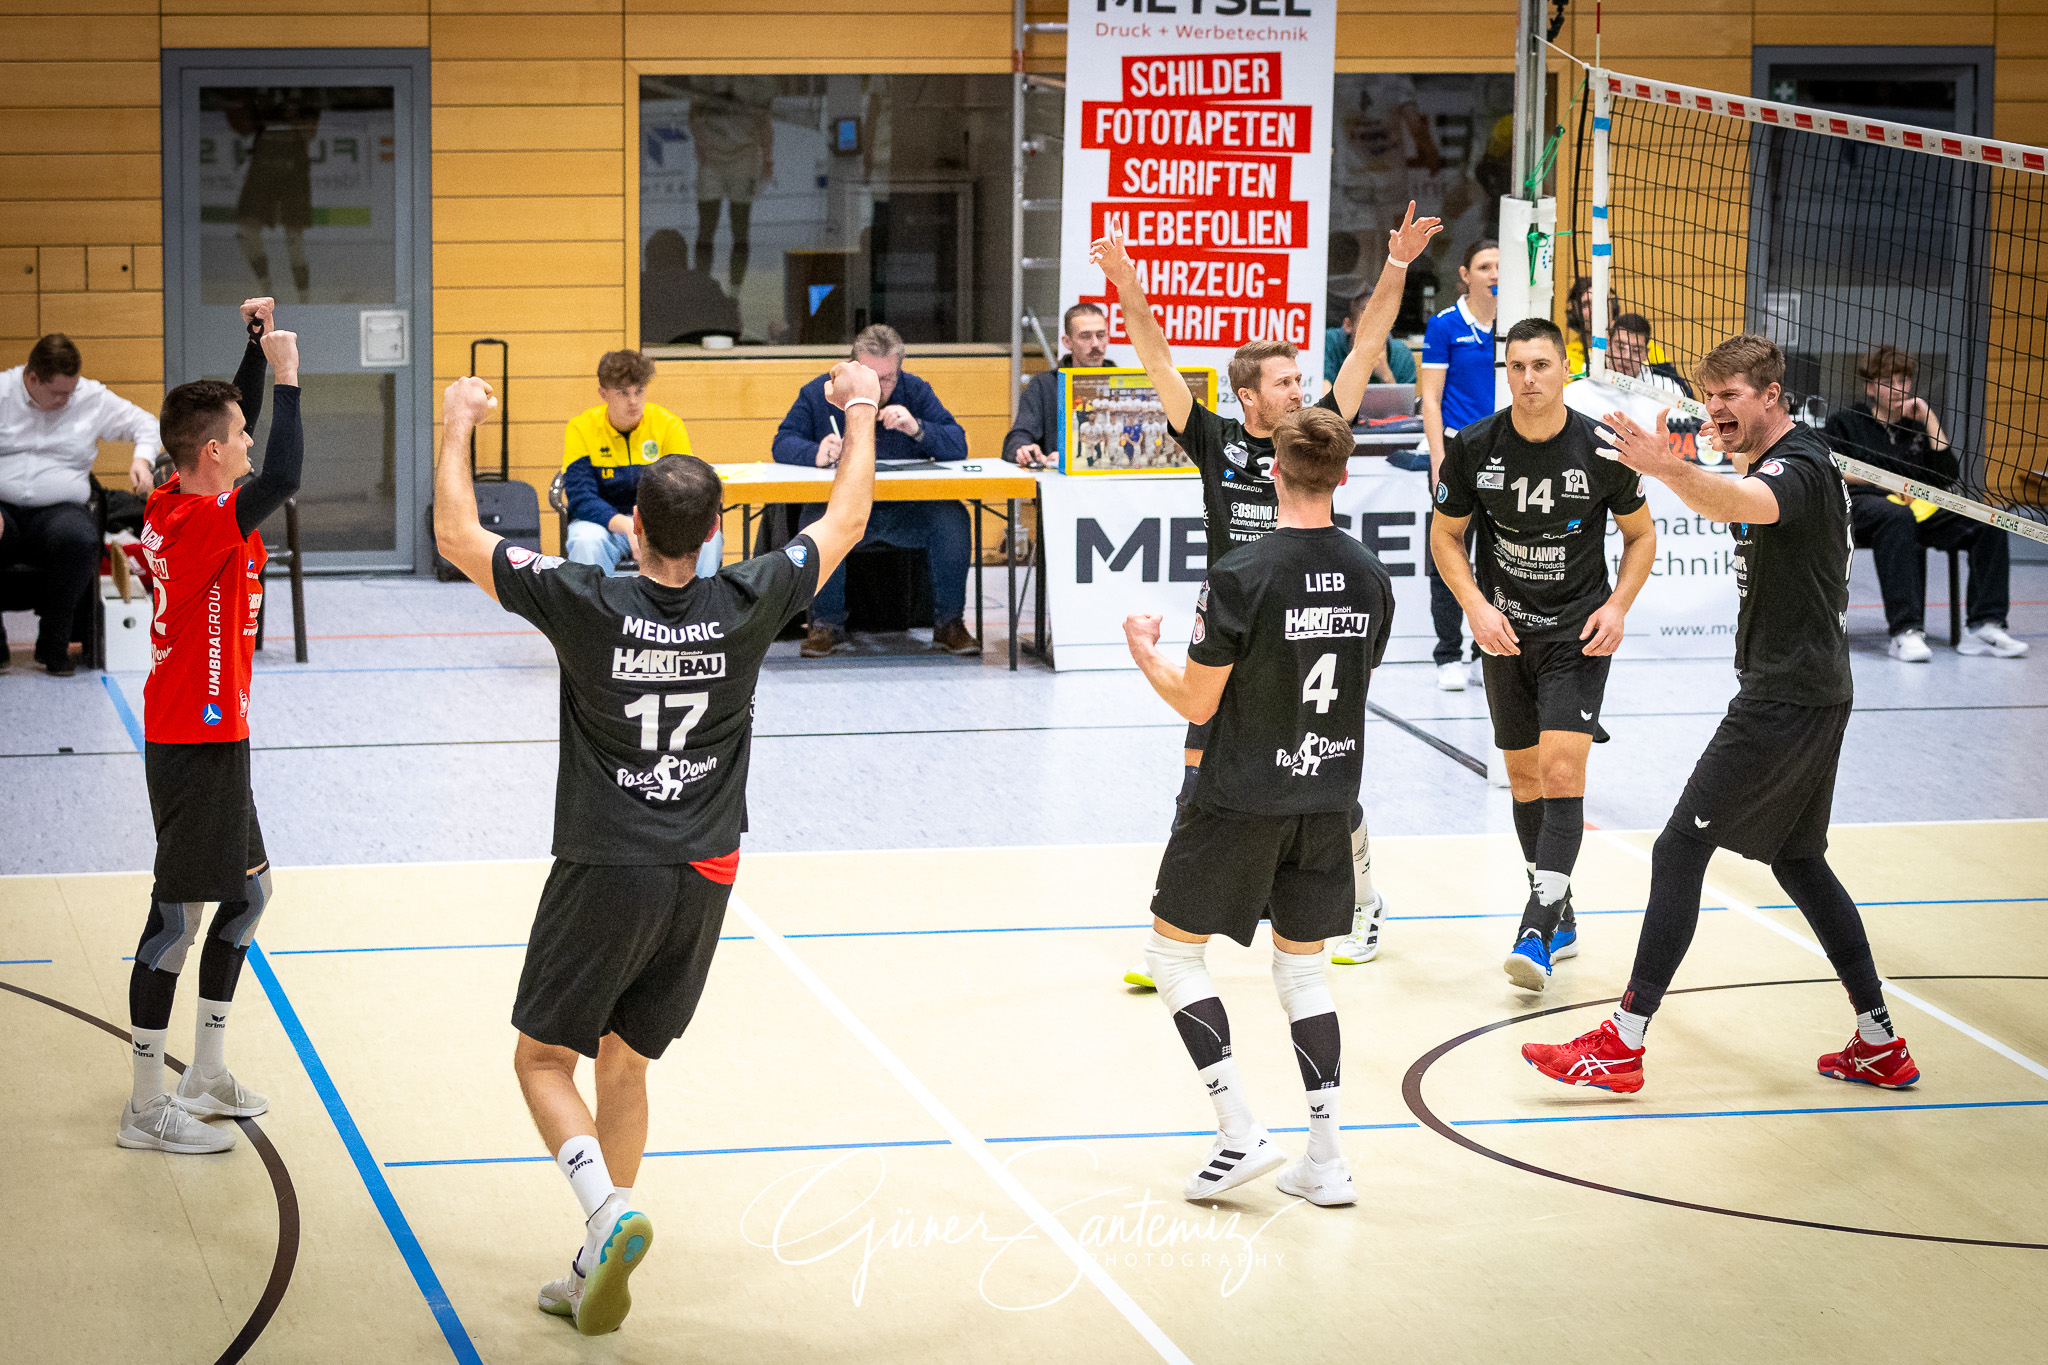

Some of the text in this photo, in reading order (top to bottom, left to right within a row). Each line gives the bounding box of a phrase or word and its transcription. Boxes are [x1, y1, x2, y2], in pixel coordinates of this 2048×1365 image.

[1095, 22, 1151, 38] Druck
[1175, 24, 1308, 42] Werbetechnik
[1130, 58, 1270, 97] SCHILDER
[1095, 108, 1296, 148] FOTOTAPETEN
[1122, 157, 1277, 198] SCHRIFTEN
[1103, 209, 1292, 246] KLEBEFOLIEN
[1133, 259, 1282, 298] AHRZEUG-
[1093, 302, 1305, 344] ECHRIFTUNG
[1485, 463, 1506, 472] erima
[1511, 477, 1555, 514] 14
[1909, 484, 1931, 501] FUCHS
[1238, 503, 1272, 520] OSHINO
[1996, 514, 2019, 532] FUCHS
[1076, 511, 1432, 583] MEE
[1529, 546, 1566, 562] LAMPS
[1305, 572, 1346, 593] LIEB
[1285, 607, 1367, 635] HART BAU
[1333, 606, 1352, 614] GmbH
[622, 615, 725, 644] MEDURIC
[1660, 622, 1737, 636] www.me
[612, 647, 723, 678] HART BAU
[1302, 653, 1339, 714] 4
[624, 691, 709, 751] 17
[1319, 735, 1356, 757] Down
[616, 755, 718, 788] Pose Down
